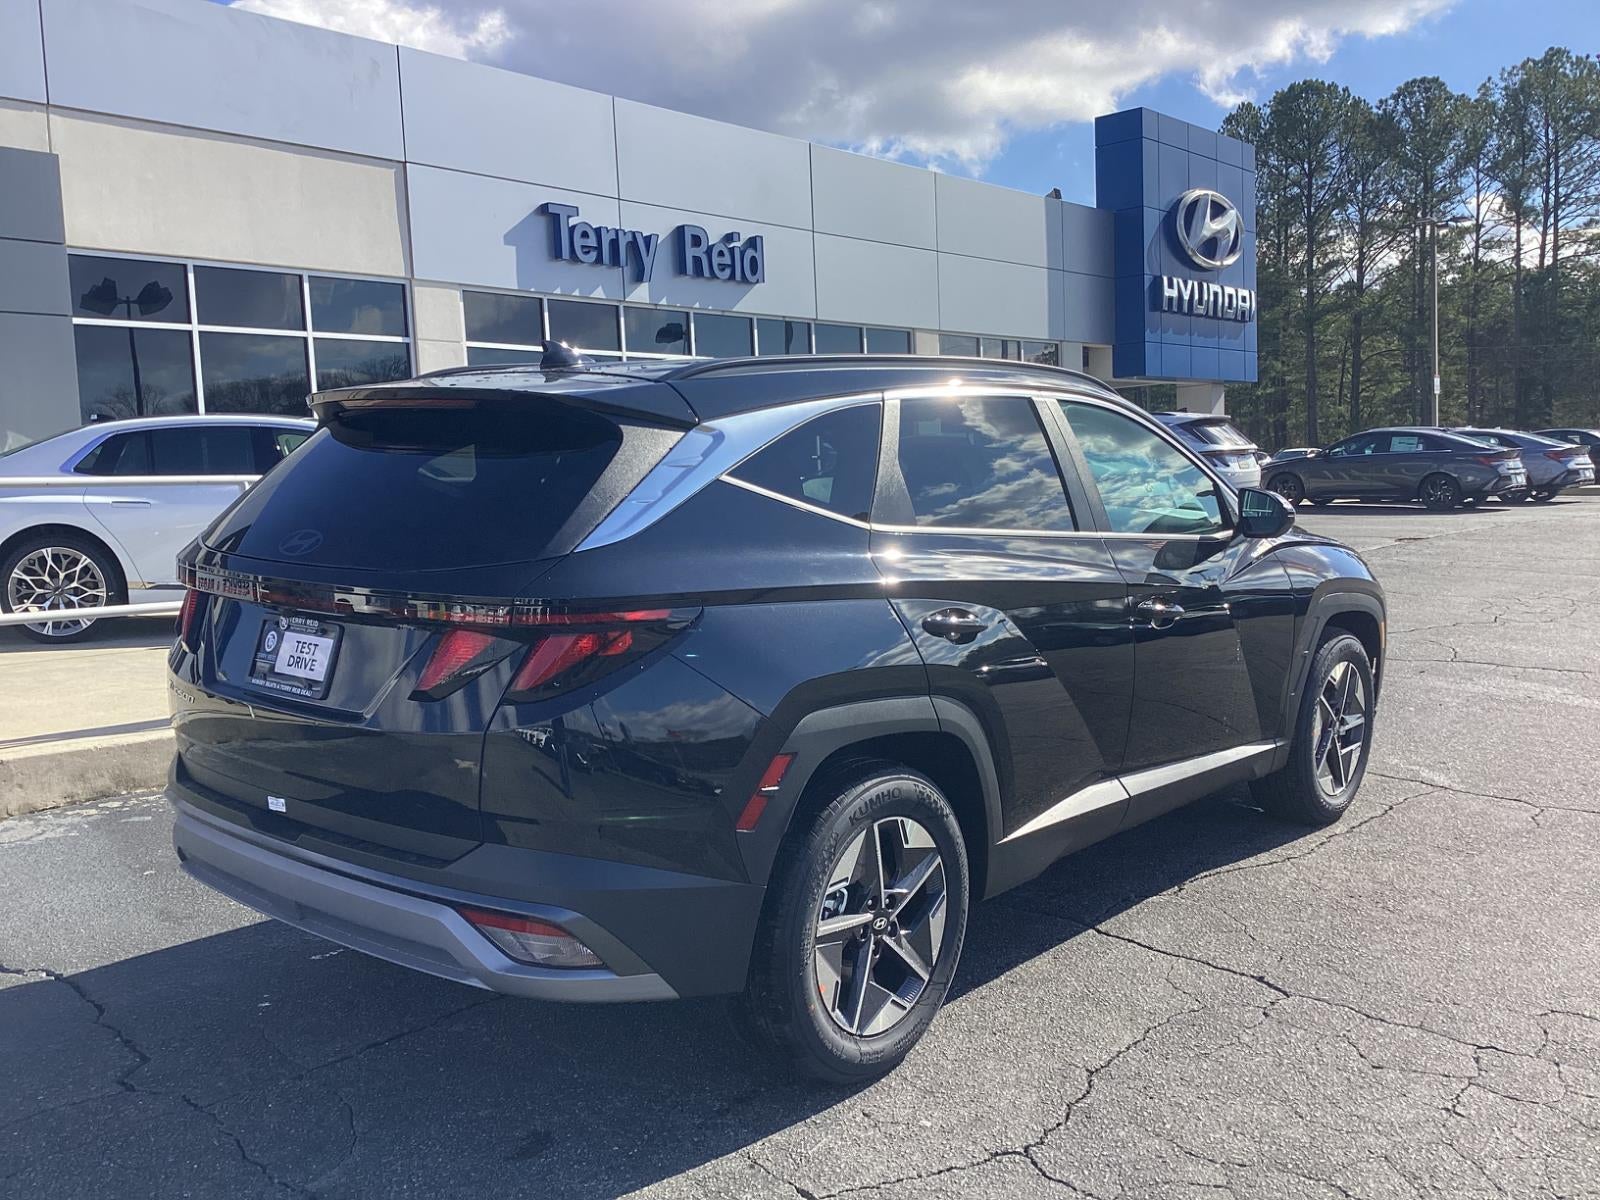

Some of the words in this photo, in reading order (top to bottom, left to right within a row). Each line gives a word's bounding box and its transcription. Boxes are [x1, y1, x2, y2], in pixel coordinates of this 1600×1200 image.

[540, 202, 659, 282] Terry
[677, 223, 765, 283] Reid
[1161, 275, 1256, 322] HYUNDAI
[287, 655, 318, 672] DRIVE
[295, 640, 319, 656] TEST
[848, 787, 903, 826] KUMHO
